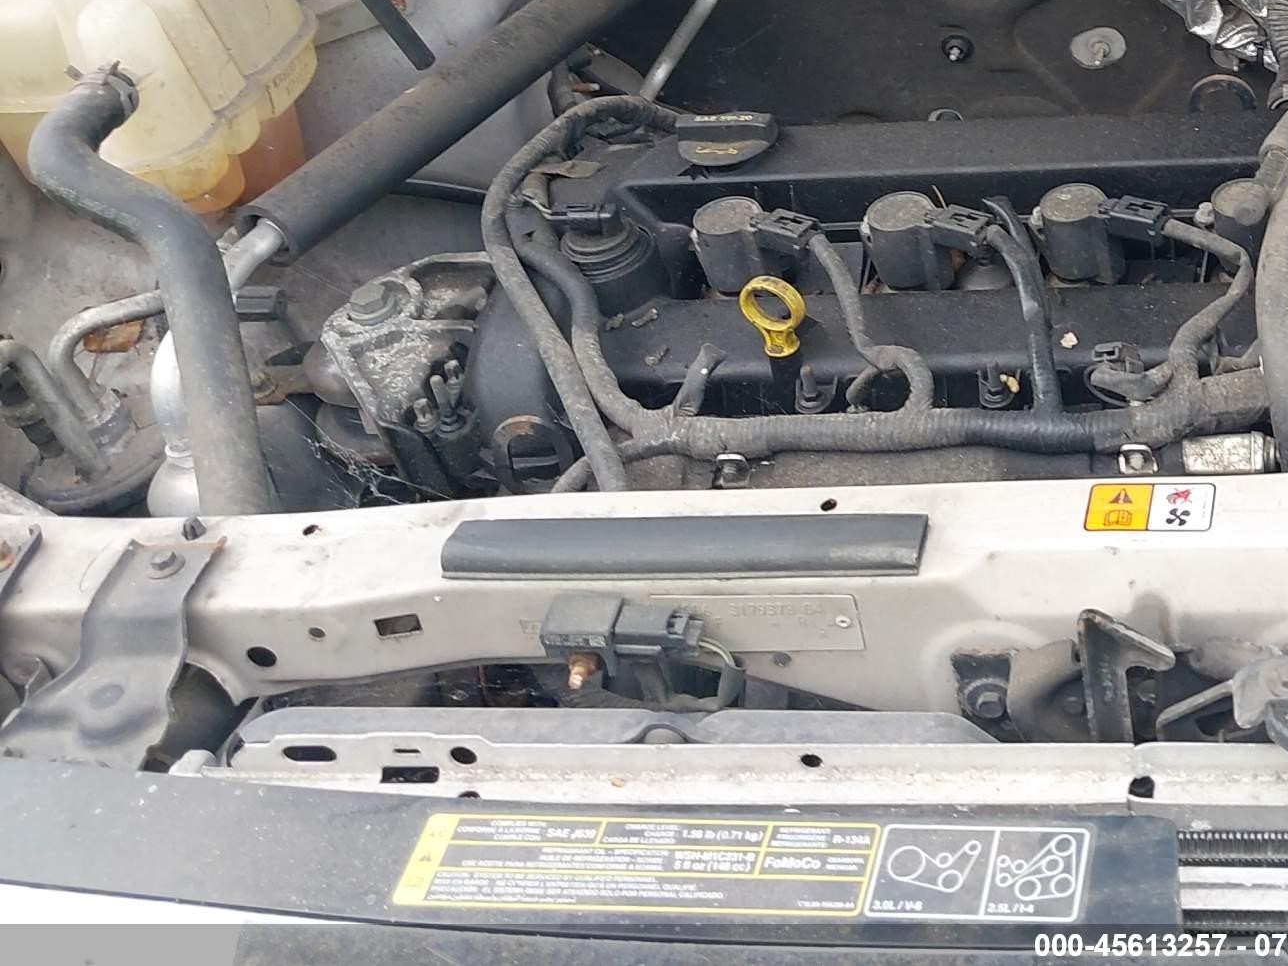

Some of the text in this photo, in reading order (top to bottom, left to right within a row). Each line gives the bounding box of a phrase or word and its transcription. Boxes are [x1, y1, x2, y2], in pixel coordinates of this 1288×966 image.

[547, 828, 570, 838] SAE
[763, 856, 821, 869] FoMoCo
[872, 900, 896, 910] 3.0L
